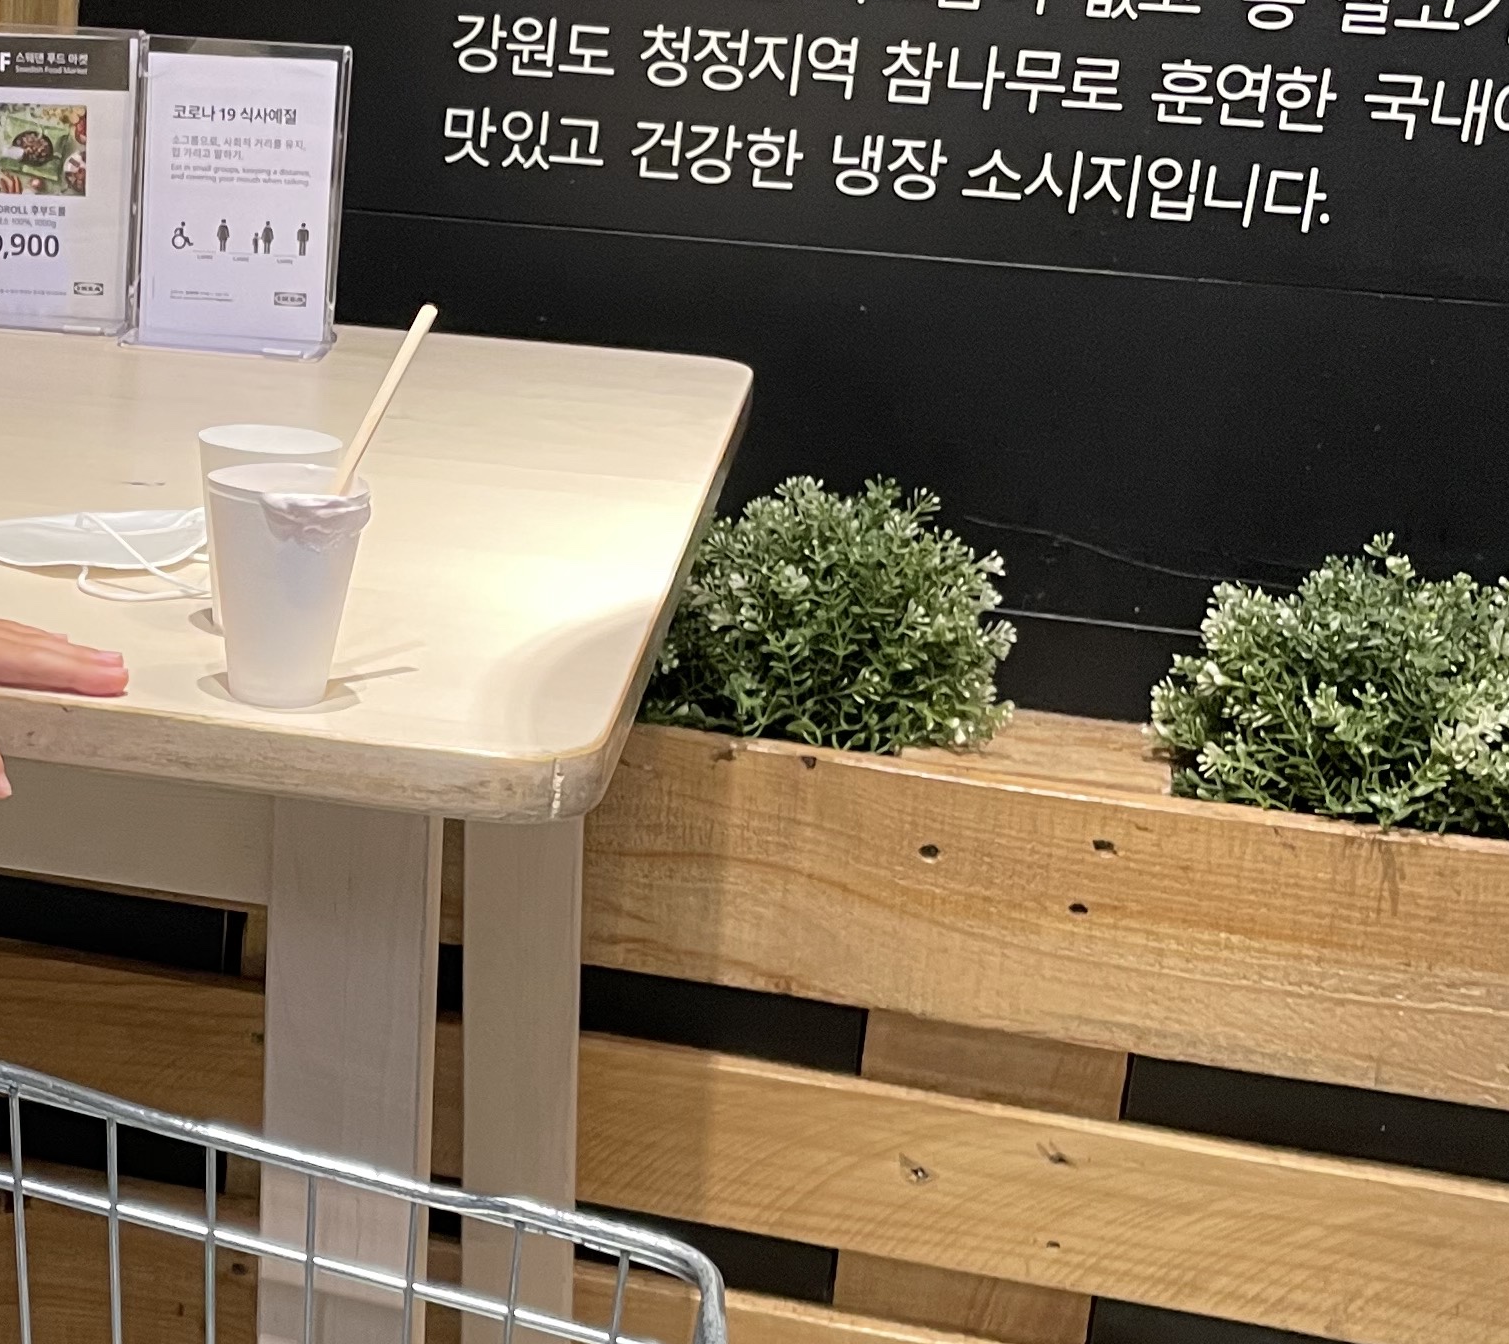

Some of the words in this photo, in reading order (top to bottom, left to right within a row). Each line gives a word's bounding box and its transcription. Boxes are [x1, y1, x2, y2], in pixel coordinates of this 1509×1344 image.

[173, 104, 215, 121] 코로나
[219, 107, 236, 121] 19
[240, 107, 297, 125] 식사예절
[452, 13, 615, 78] 강원도
[640, 23, 859, 100] 청정지역
[881, 39, 1123, 114] 참나무로
[1150, 58, 1338, 133] 훈연한
[444, 106, 604, 170] 맛있고
[631, 120, 804, 190] 건강한
[832, 134, 948, 201] 냉장
[961, 148, 1330, 234] 소시지입니다.
